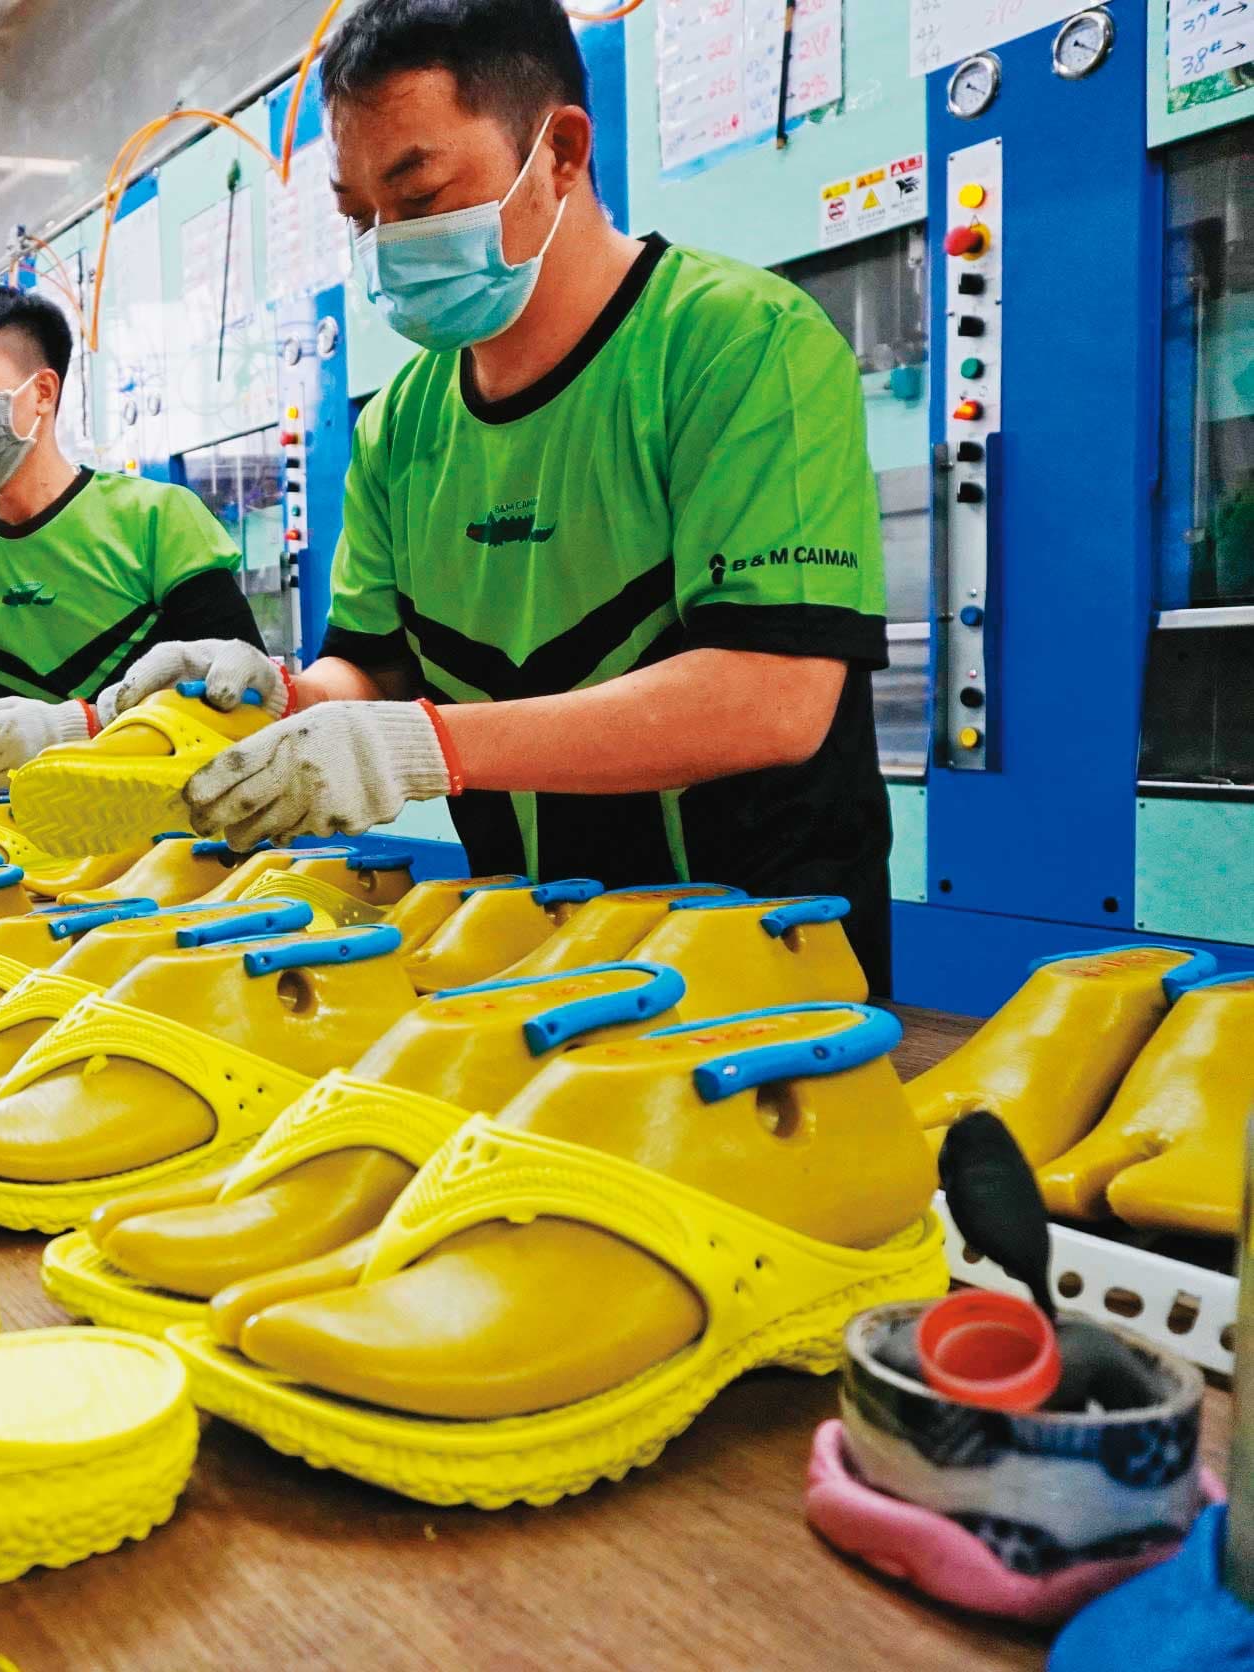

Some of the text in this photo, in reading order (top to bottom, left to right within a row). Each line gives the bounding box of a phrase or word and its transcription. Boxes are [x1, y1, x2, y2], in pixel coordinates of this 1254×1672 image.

[732, 546, 858, 572] B & M CAIMAN
